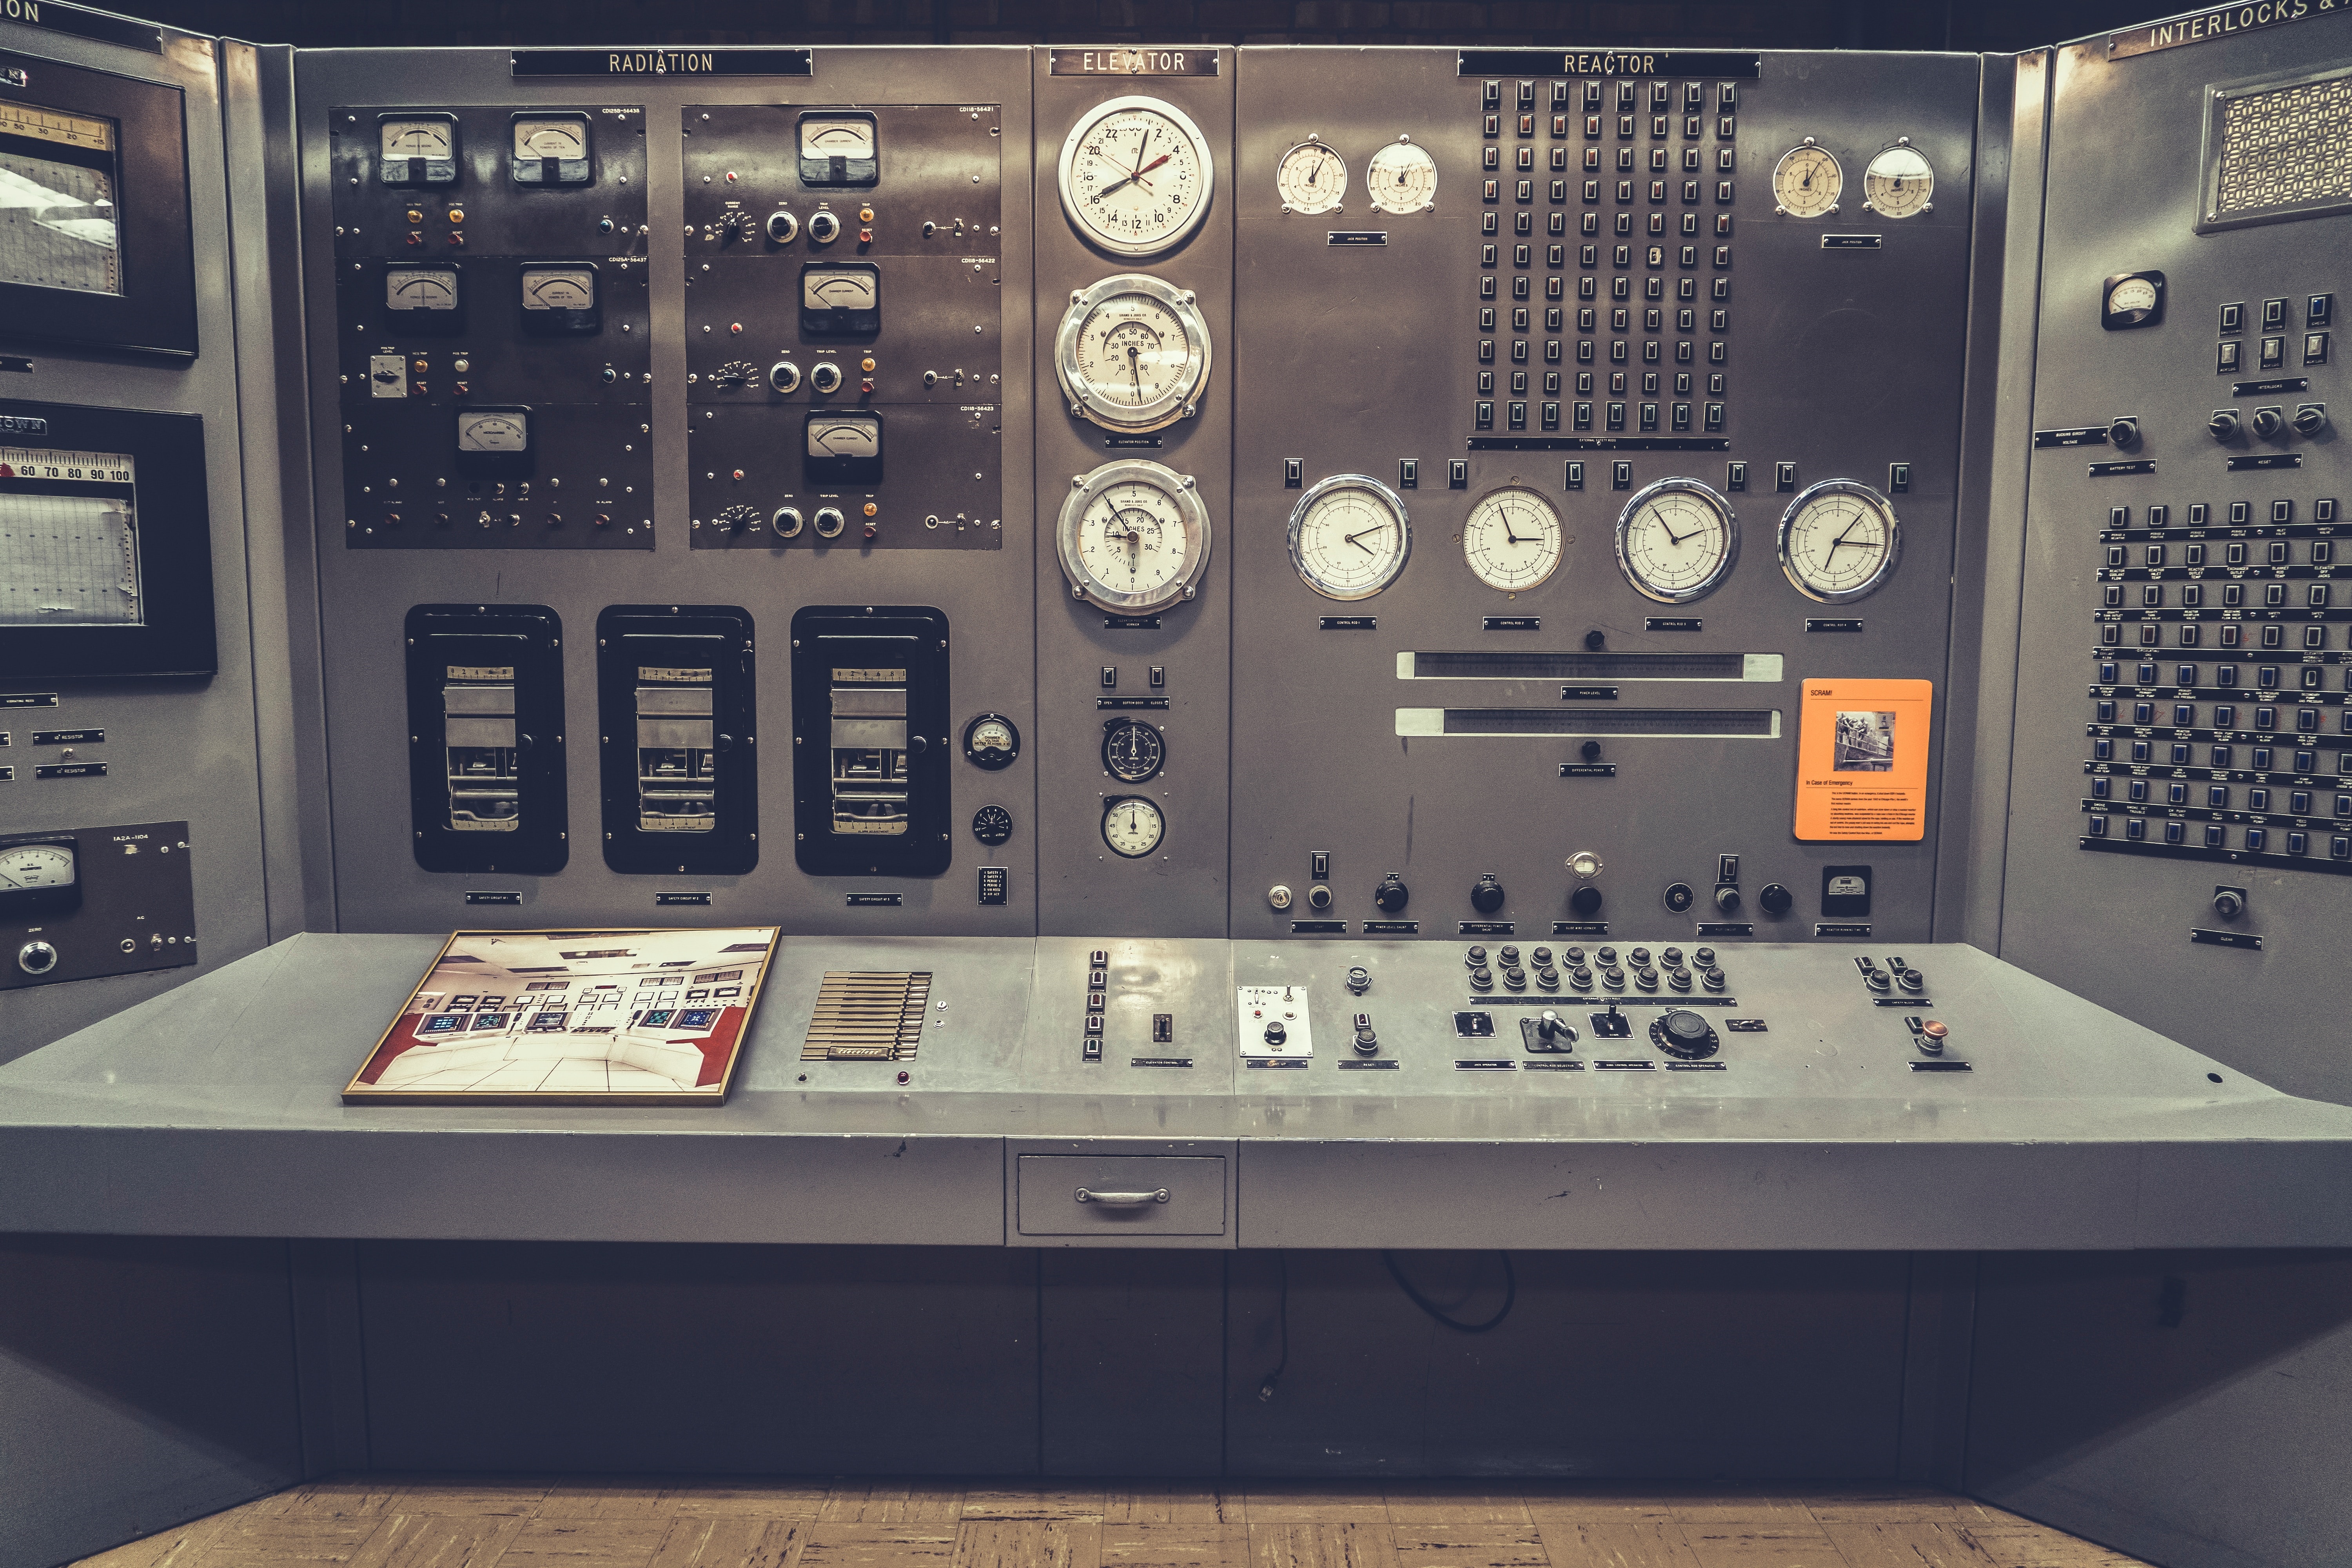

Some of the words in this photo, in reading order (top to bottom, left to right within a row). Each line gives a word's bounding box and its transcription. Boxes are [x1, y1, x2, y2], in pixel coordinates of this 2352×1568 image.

[2149, 0, 2307, 49] INTERLOCKS
[2320, 0, 2334, 9] &
[610, 54, 711, 74] RADIATION
[1084, 52, 1184, 71] ELEVATOR
[1565, 55, 1653, 75] REACTOR
[1106, 129, 1117, 138] 22
[1156, 129, 1161, 138] 2
[1089, 146, 1100, 154] 20
[1172, 145, 1180, 154] 4
[1083, 172, 1094, 181] 18
[1091, 196, 1100, 204] 16
[1173, 194, 1180, 204] 8
[1108, 214, 1118, 223] 14
[1154, 213, 1164, 223] 10
[1132, 220, 1142, 229] 12
[21, 466, 35, 476] 60
[44, 467, 58, 477] 70
[68, 468, 81, 478] 80
[91, 470, 104, 479] 90
[111, 471, 129, 481] 100
[838, 1047, 879, 1055] Executone
